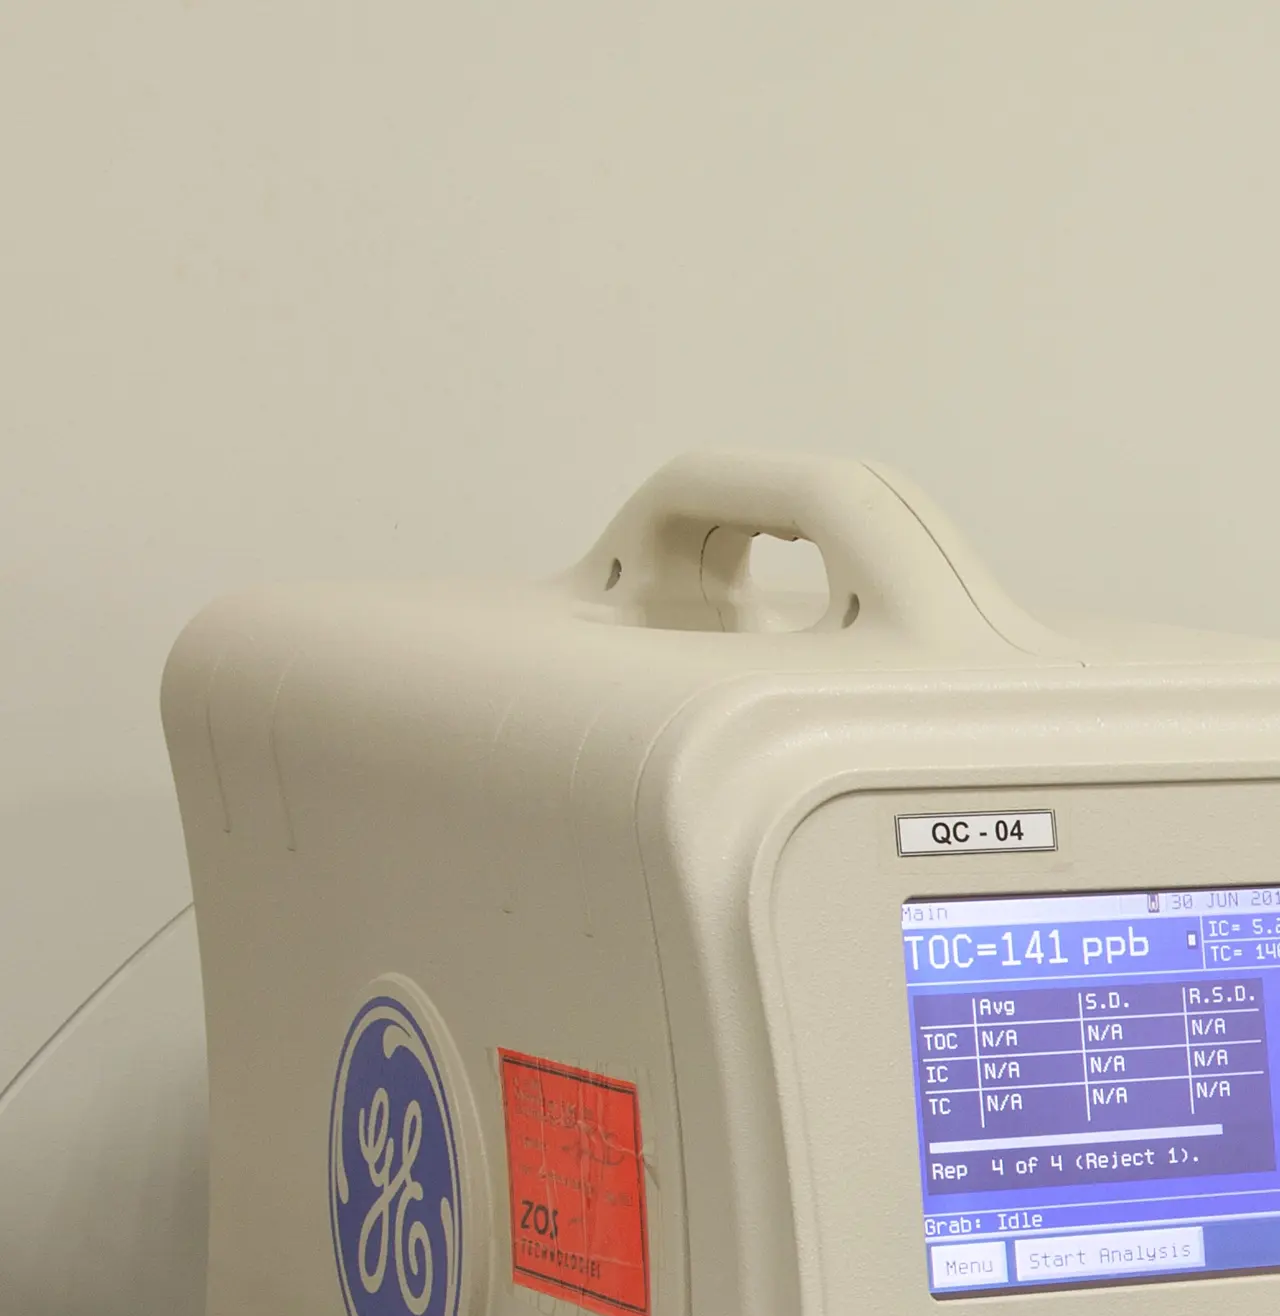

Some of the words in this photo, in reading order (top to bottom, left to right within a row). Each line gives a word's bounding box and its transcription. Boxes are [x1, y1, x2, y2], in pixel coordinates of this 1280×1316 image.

[931, 821, 970, 846] QC
[994, 820, 1025, 843] 04
[902, 905, 948, 923] Main
[1171, 894, 1194, 910] 30
[1206, 892, 1240, 909] JUN
[1208, 919, 1241, 938] IC=
[903, 929, 1069, 971] TOC=141
[1082, 926, 1150, 966] ppb
[1210, 945, 1243, 963] TC=
[979, 998, 1016, 1017] Avg
[1085, 991, 1130, 1011] S.D.
[1188, 984, 1256, 1006] R.S.D.
[923, 1032, 959, 1052] TOC
[981, 1028, 1019, 1049] N/A
[1087, 1023, 1124, 1043] N/A
[1191, 1017, 1227, 1036] N/A
[926, 1065, 949, 1084] IC
[983, 1061, 1021, 1080] N/A
[1089, 1054, 1127, 1074] N/A
[1193, 1048, 1229, 1068] N/A
[928, 1097, 952, 1116] TC
[986, 1092, 1024, 1113] N/A
[1092, 1086, 1129, 1106] N/A
[1196, 1080, 1232, 1099] N/A
[931, 1162, 968, 1182] Rep
[991, 1159, 1005, 1176] 4
[1015, 1156, 1039, 1175] of
[1050, 1154, 1064, 1172] 4
[1075, 1149, 1156, 1171] (Reject
[923, 1216, 982, 1237] Grab:
[997, 1211, 1044, 1232] Idle
[945, 1257, 994, 1277] Menu
[1028, 1249, 1087, 1271] Start
[1099, 1243, 1192, 1265] Analysis
